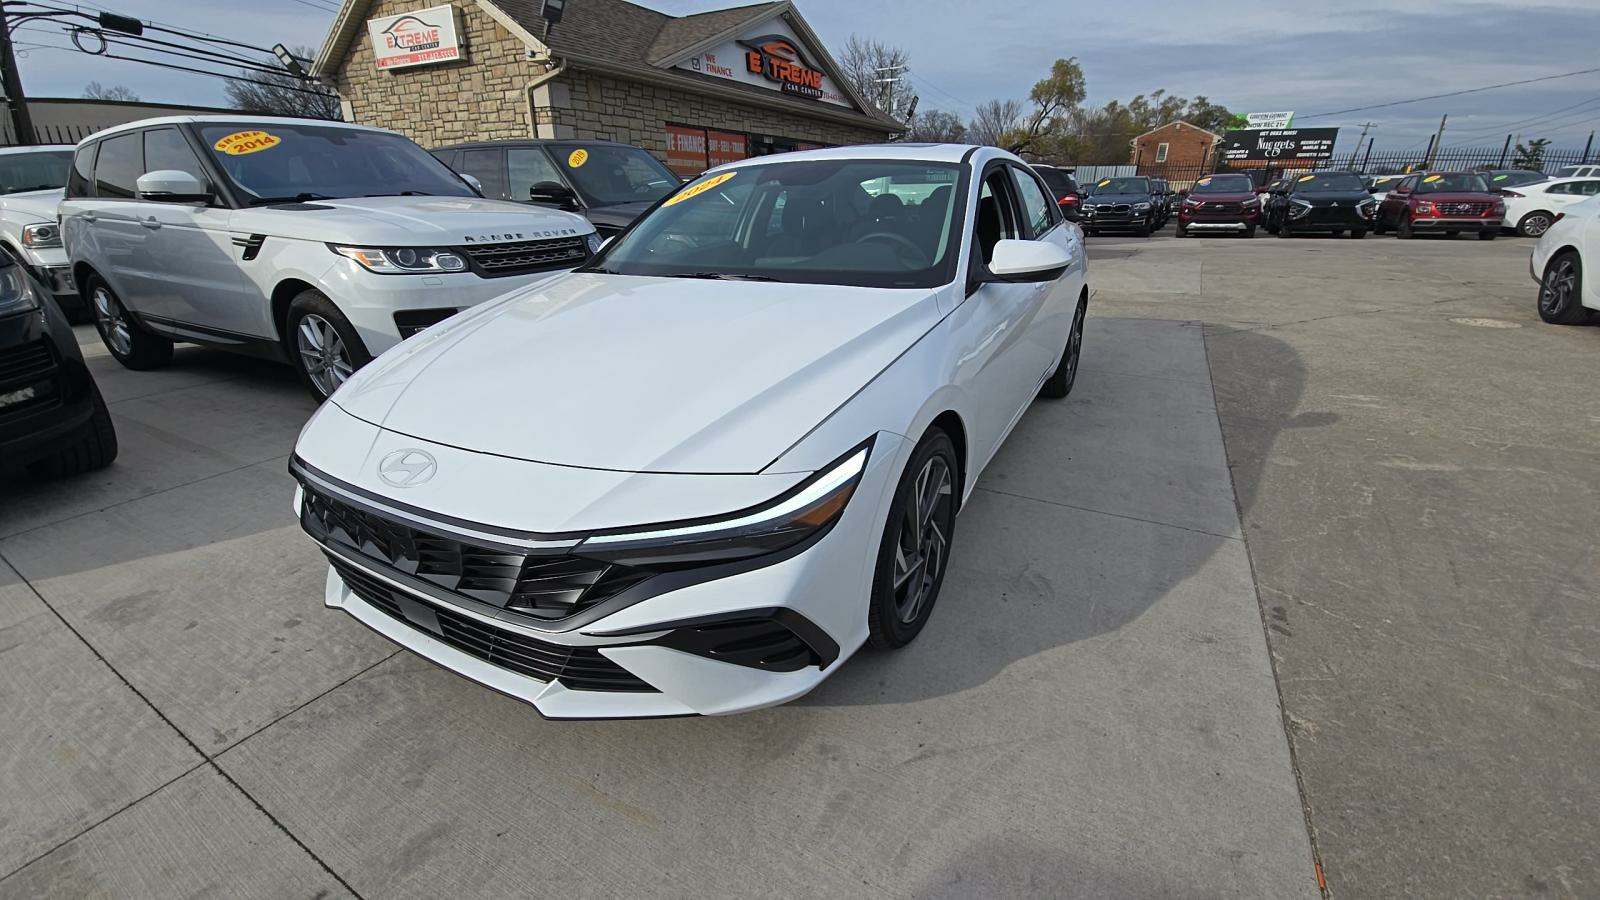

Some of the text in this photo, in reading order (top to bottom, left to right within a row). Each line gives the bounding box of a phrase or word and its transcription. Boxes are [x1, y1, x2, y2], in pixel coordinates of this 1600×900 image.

[385, 30, 440, 48] EXTREME
[705, 53, 716, 63] WE
[706, 63, 733, 77] FINANCE
[746, 48, 823, 89] EXTREME
[787, 82, 799, 92] CAR
[801, 86, 821, 97] CENTER
[234, 137, 275, 152] 2014
[677, 134, 705, 154] FINANCE
[1257, 138, 1295, 156] Nuggets
[464, 228, 577, 242] RANGE ROVER
